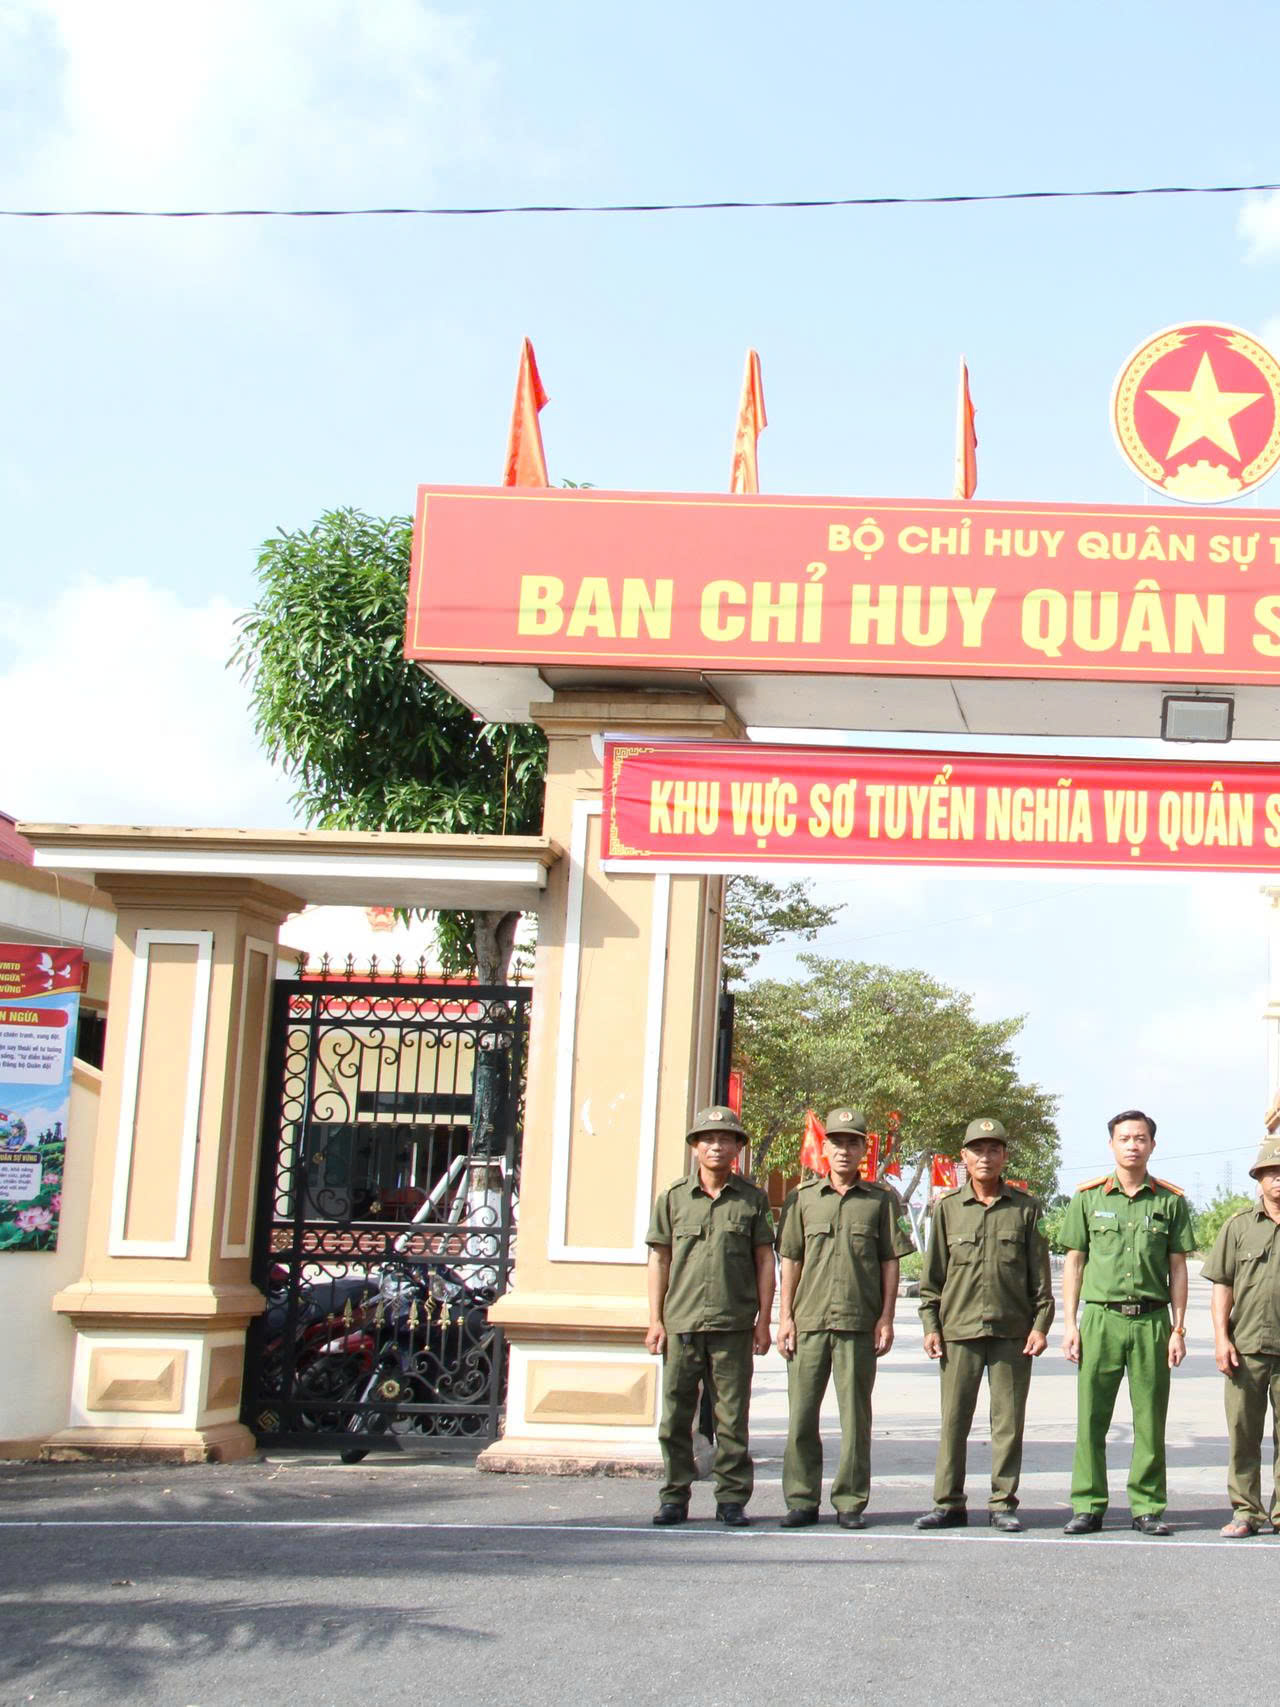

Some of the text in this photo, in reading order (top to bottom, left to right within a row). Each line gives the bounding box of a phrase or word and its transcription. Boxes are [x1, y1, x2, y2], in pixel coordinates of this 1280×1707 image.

[828, 517, 884, 561] BỘ
[898, 517, 972, 555] CHỈ
[985, 529, 1065, 557] HUY
[1077, 526, 1195, 561] QUÂN
[1209, 532, 1261, 571] SỰ
[517, 575, 674, 640] BAN
[700, 563, 827, 644] CHỈ
[850, 584, 997, 648] HUY
[1021, 579, 1226, 658] QUÂN
[649, 780, 721, 836] KHU
[731, 777, 798, 849] VỰC
[809, 778, 857, 838] SƠ
[866, 765, 975, 840] TUYỂN
[986, 778, 1093, 843] NGHĨA
[1104, 791, 1148, 857] VỤ
[1158, 781, 1253, 852] QUÂN
